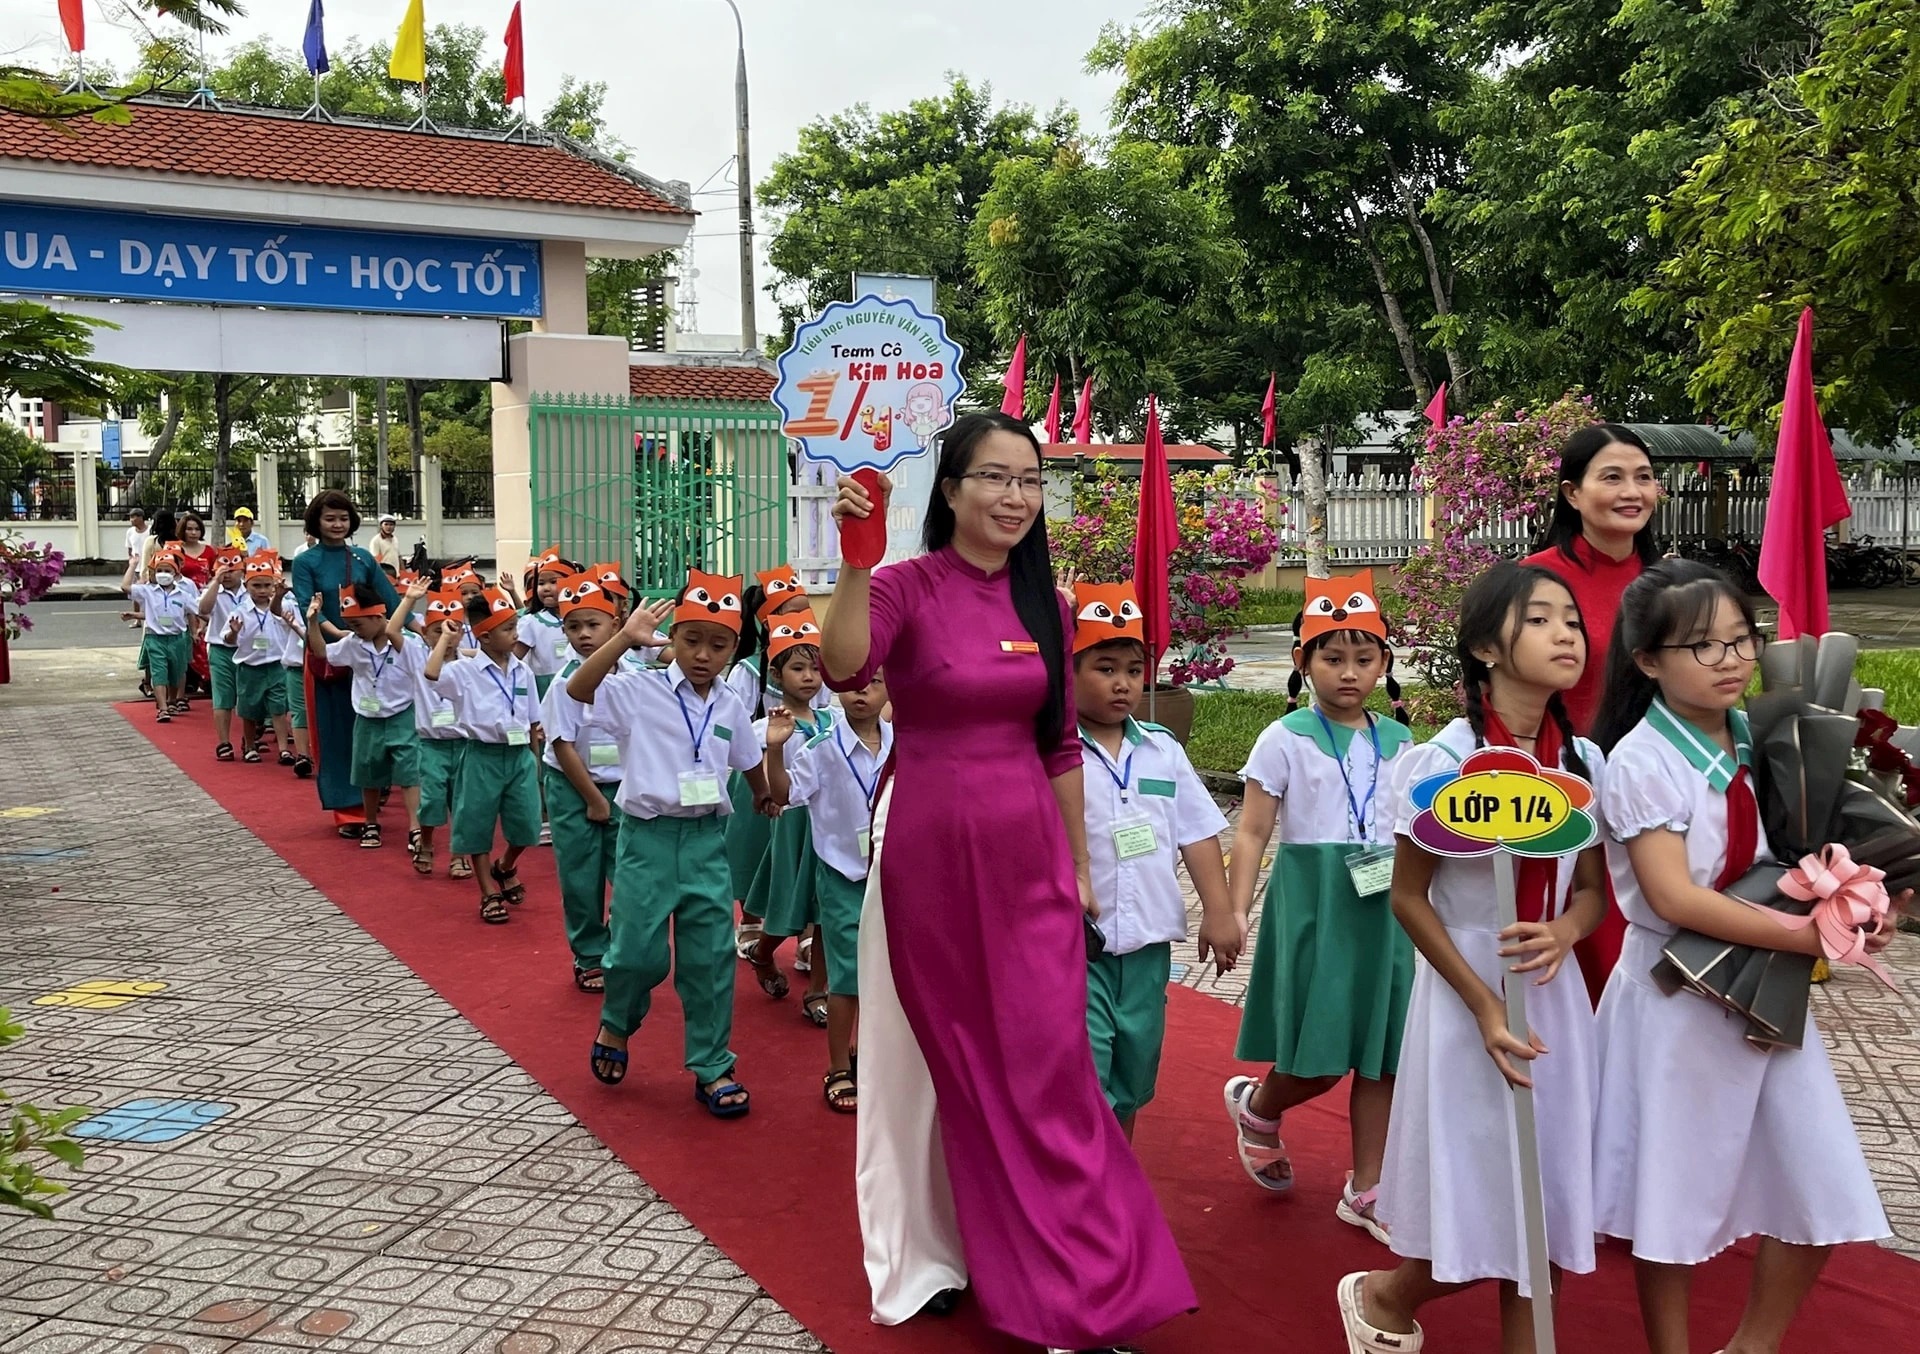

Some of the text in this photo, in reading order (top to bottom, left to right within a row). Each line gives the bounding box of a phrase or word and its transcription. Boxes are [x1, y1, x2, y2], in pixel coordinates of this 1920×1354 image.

[4, 230, 78, 271] UA
[119, 239, 218, 288] DẠY
[228, 235, 313, 286] TỐT
[351, 256, 441, 300] HỌC
[450, 249, 526, 296] TỐT
[799, 335, 823, 356] Tiểu
[820, 321, 844, 338] học
[897, 317, 921, 336] VĂN
[831, 343, 902, 358] Team Cô
[848, 362, 943, 381] Kim Hoa
[1449, 790, 1553, 823] LỚP 1/4
